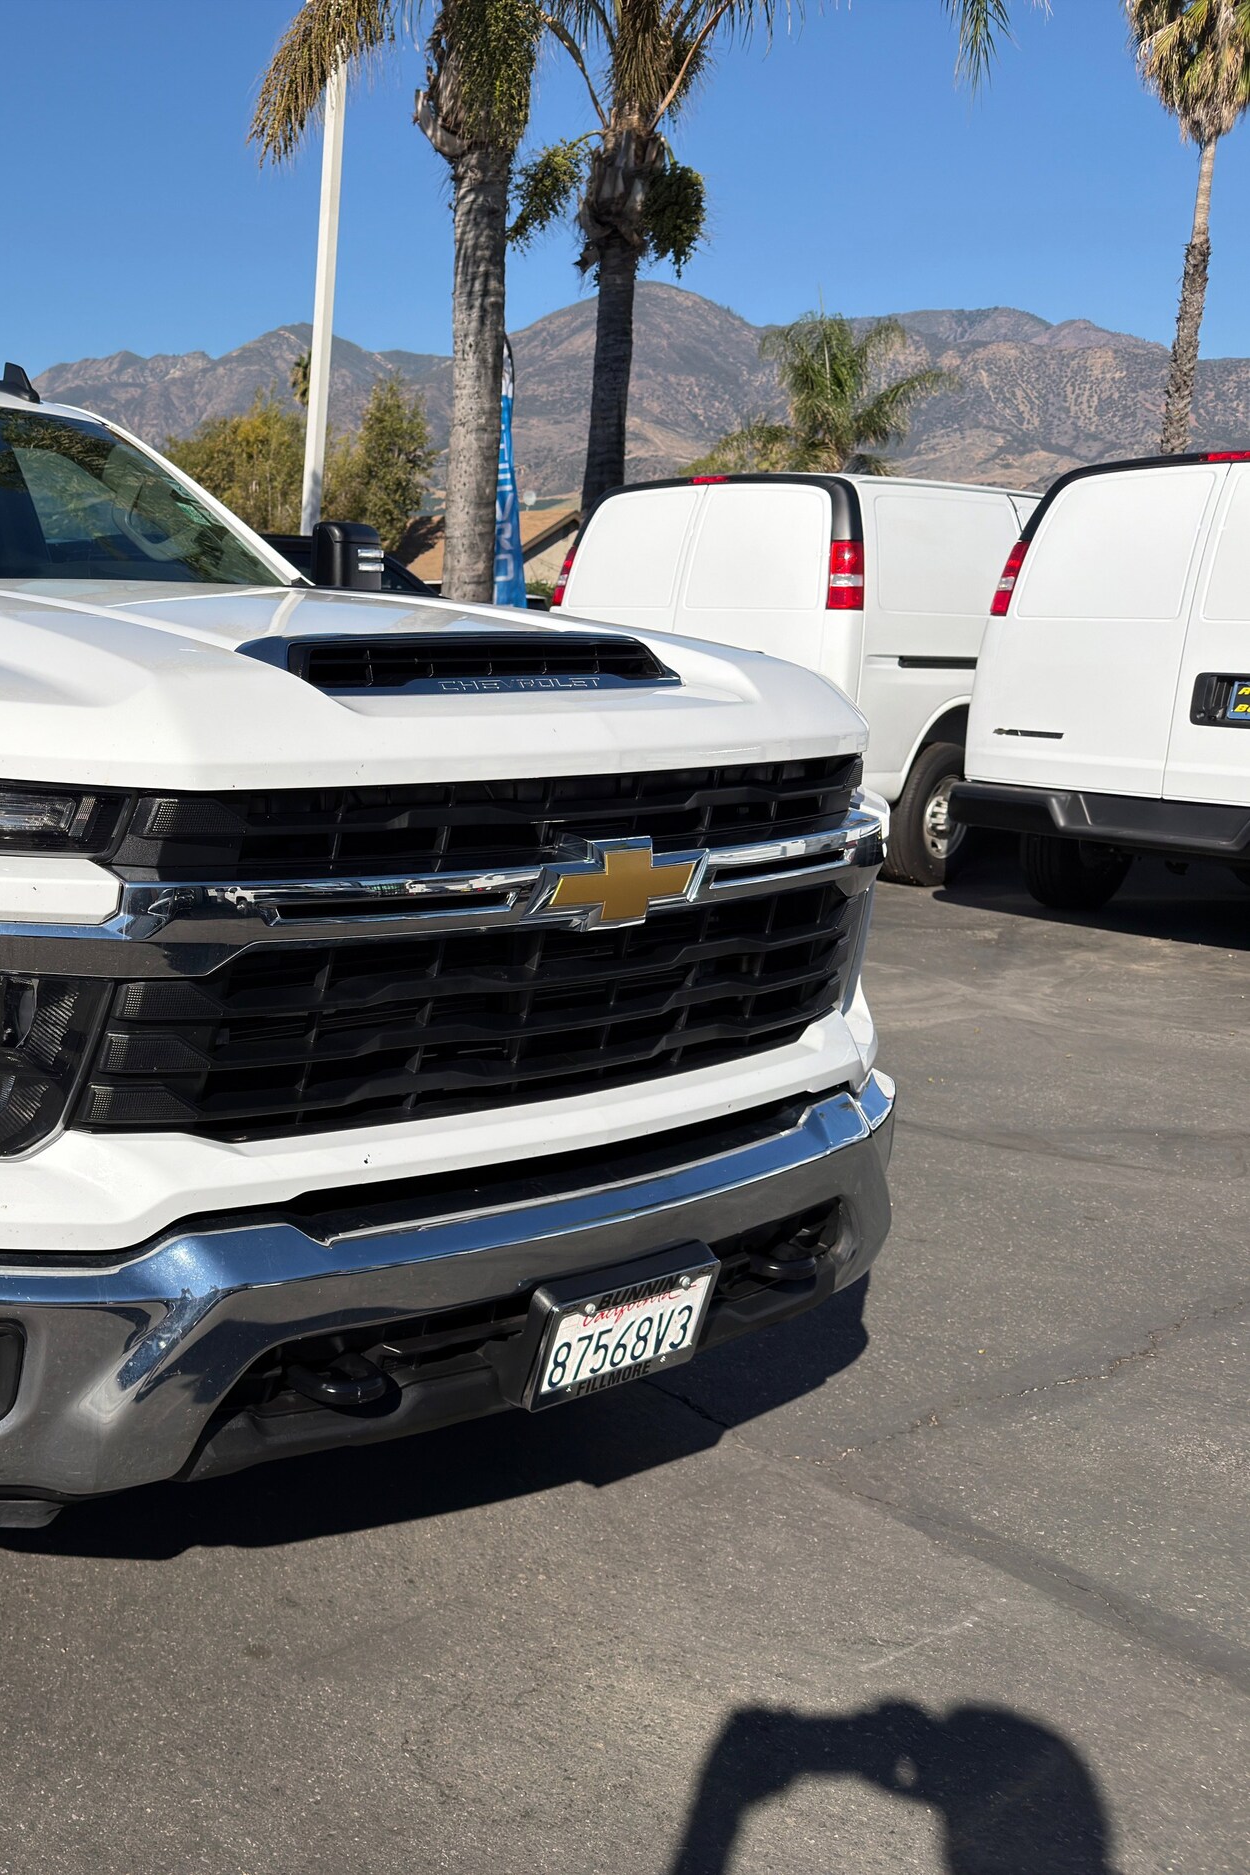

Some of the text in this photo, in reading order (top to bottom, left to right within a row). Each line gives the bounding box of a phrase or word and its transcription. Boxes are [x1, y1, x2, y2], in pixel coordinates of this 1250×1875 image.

[438, 677, 600, 691] CHEVROLET
[597, 1274, 680, 1310] BUNNIN
[547, 1304, 693, 1388] 87568V3
[576, 1360, 651, 1397] FILLMORE
